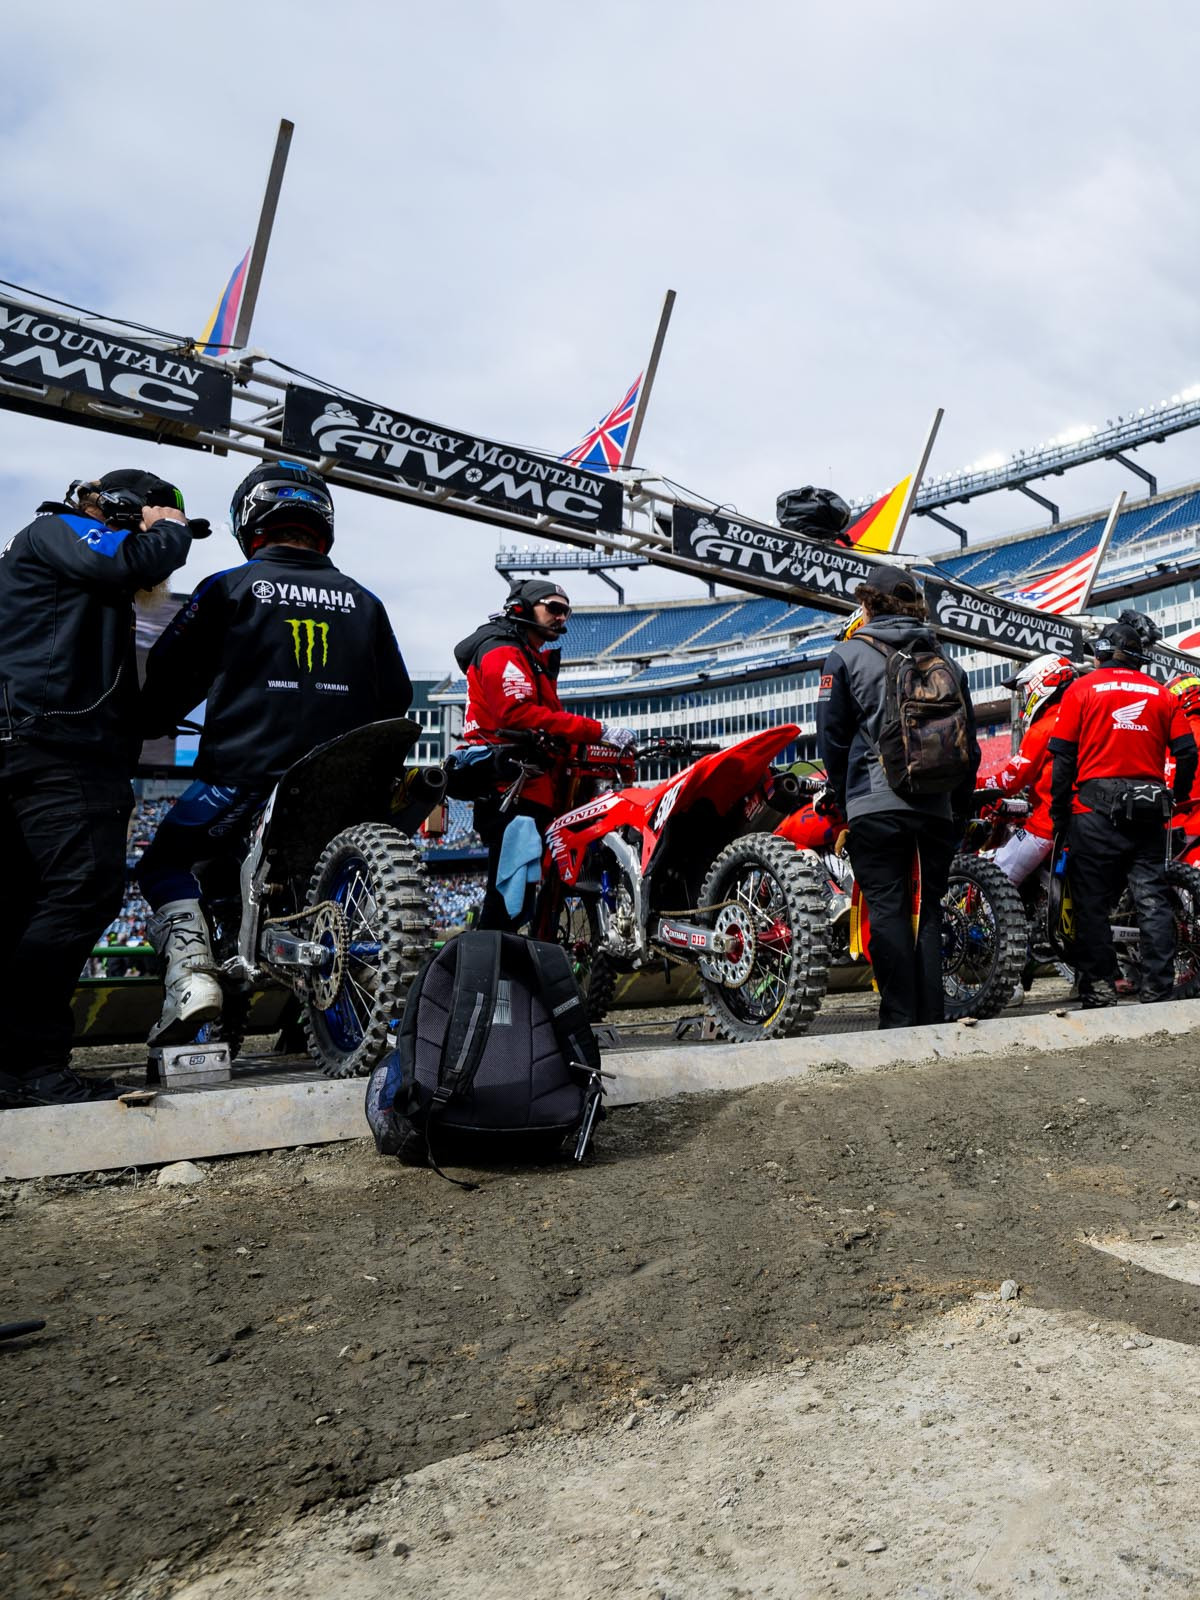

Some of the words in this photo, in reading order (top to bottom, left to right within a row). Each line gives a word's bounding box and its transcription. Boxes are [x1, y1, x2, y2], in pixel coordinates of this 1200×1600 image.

[0, 307, 203, 385] MOUNTAIN
[365, 411, 465, 454] ROCKY
[467, 440, 605, 497] MOUNTAIN
[318, 428, 468, 480] ATV
[480, 473, 602, 520] MC
[695, 538, 791, 576] ATV
[724, 522, 790, 553] ROCKY
[791, 542, 874, 577] MOUNTAI
[261, 598, 351, 613] RACING
[276, 582, 356, 609] YAMAHA
[940, 607, 1009, 637] ATV
[1014, 628, 1074, 656] MC
[960, 593, 1004, 619] ROCKY
[1007, 609, 1074, 639] MOUNTAIN
[323, 683, 349, 692] YAMAHA
[1113, 721, 1150, 732] HONDA
[553, 804, 608, 829] HONDA
[691, 933, 707, 946] DID
